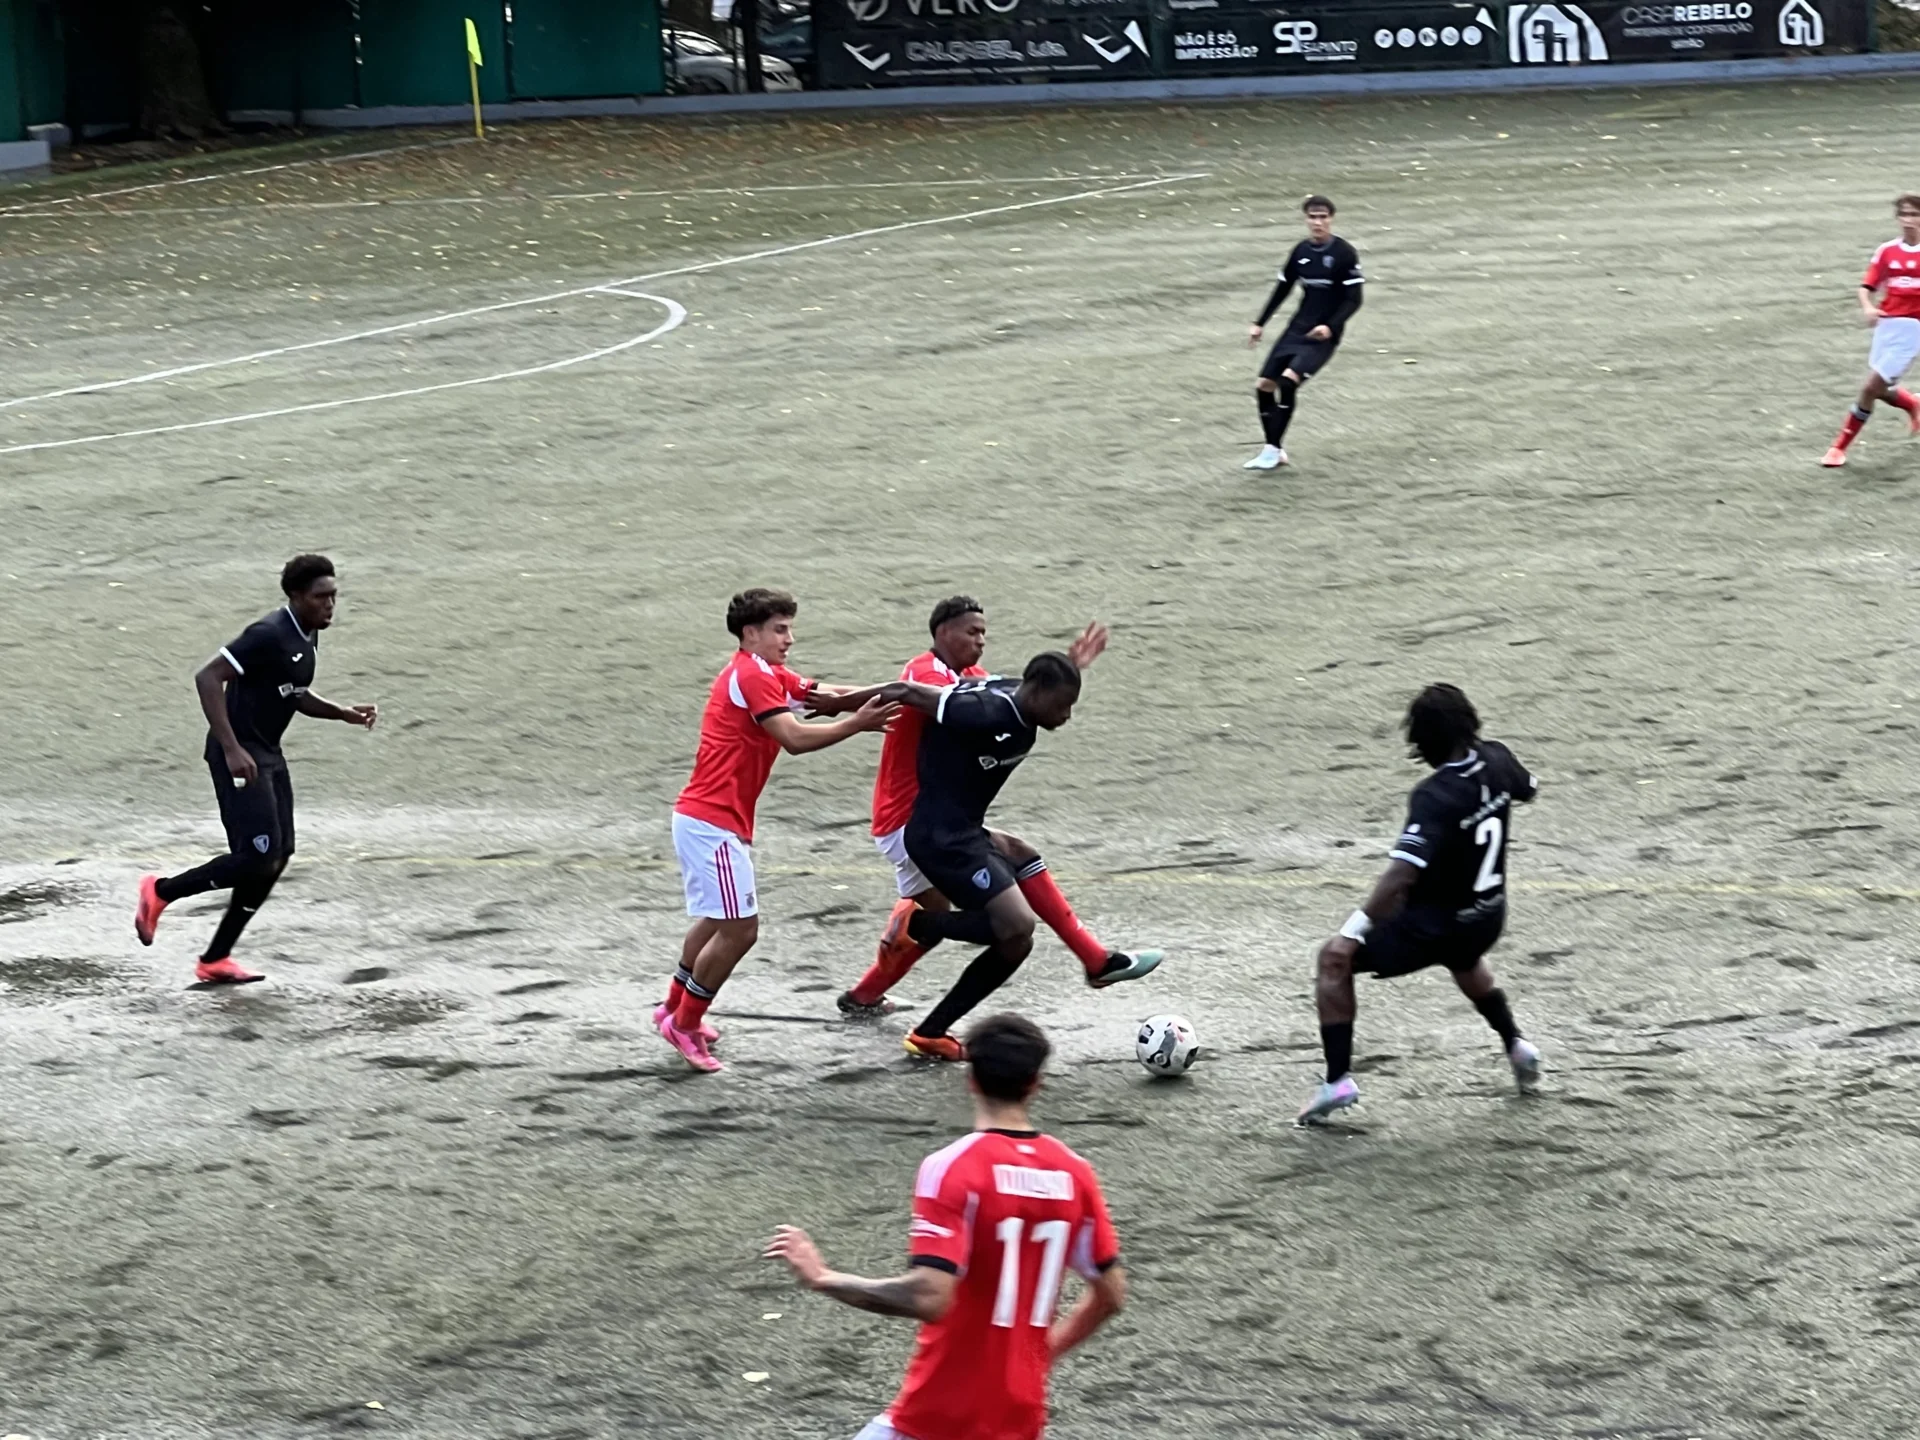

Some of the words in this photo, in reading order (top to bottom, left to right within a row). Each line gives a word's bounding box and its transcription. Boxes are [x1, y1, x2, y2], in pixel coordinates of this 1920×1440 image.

[1174, 32, 1206, 46] NÃO
[1217, 29, 1237, 45] SÓ
[1174, 44, 1259, 60] IMPRESSÃO?
[1472, 816, 1503, 892] 2
[990, 1217, 1072, 1328] 11
